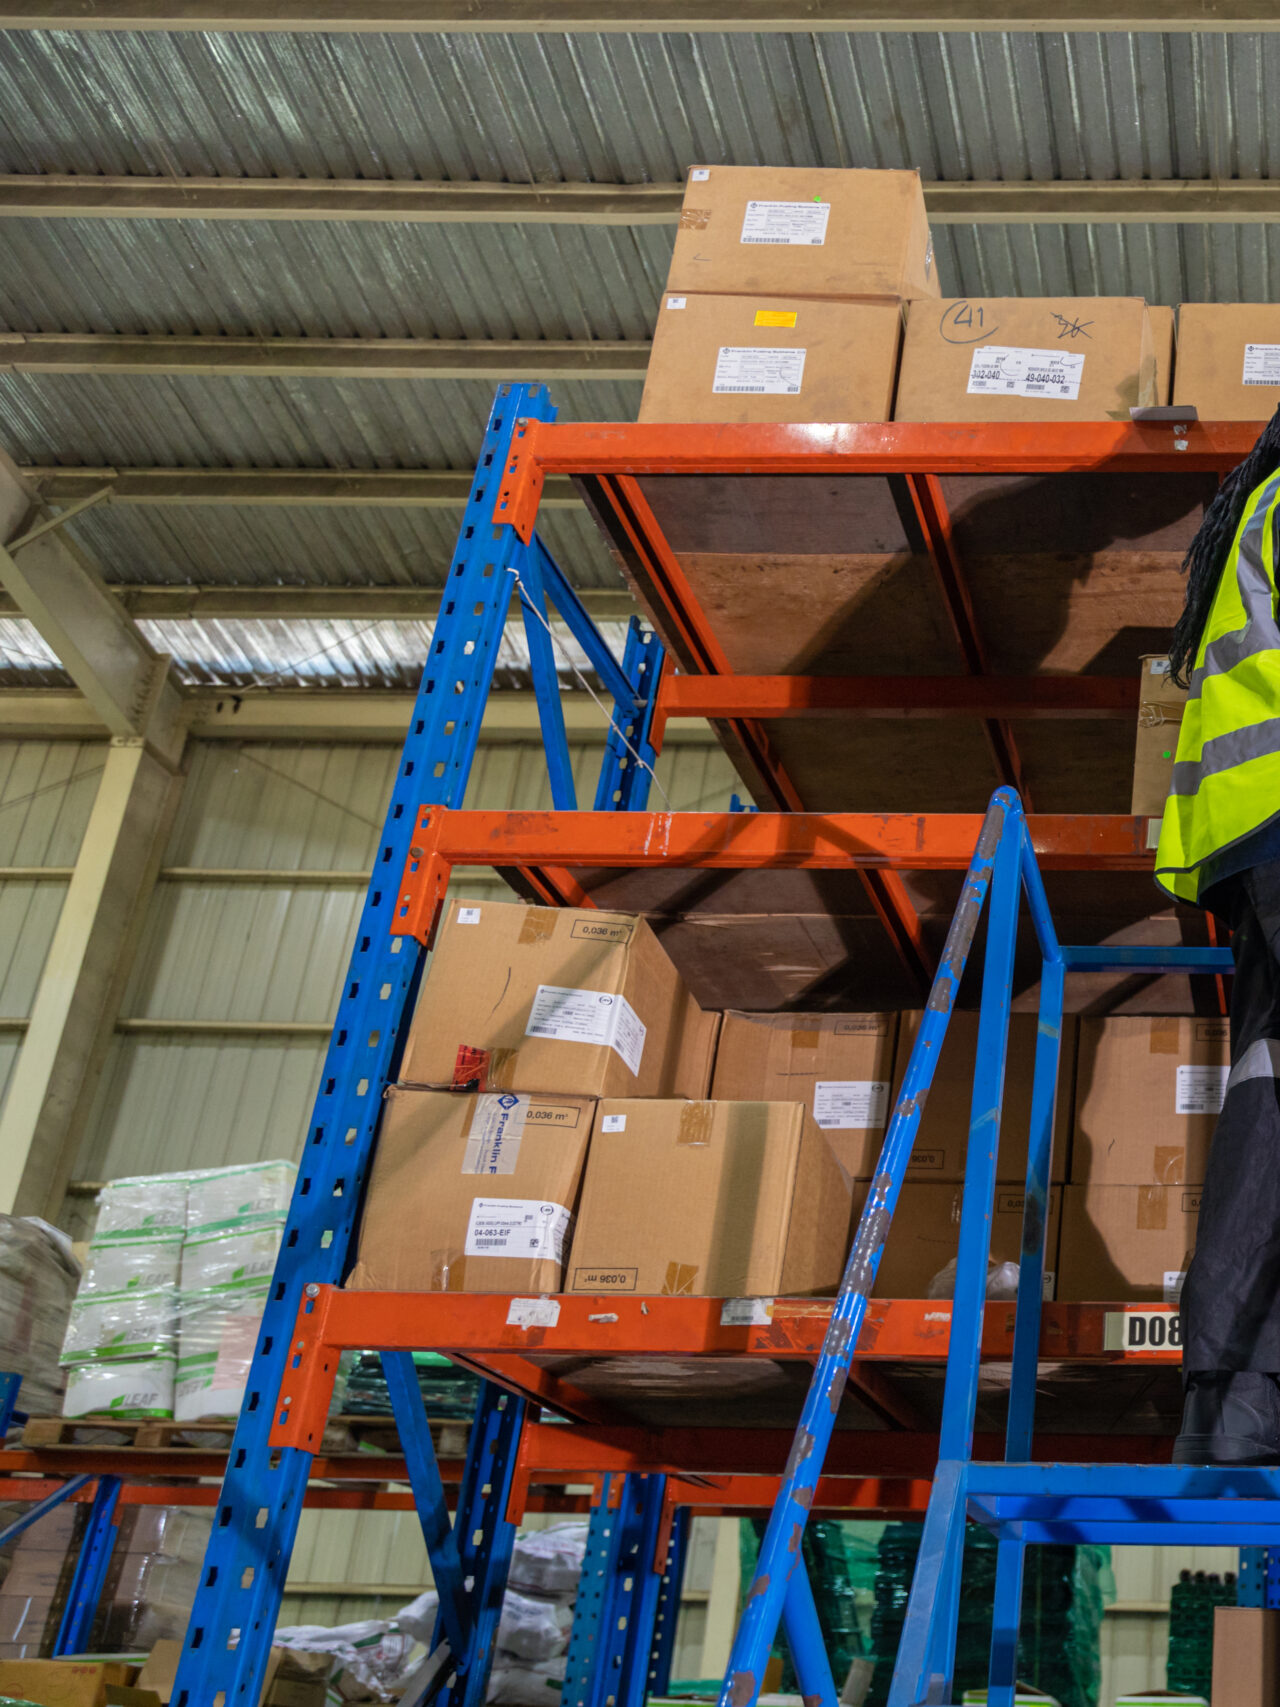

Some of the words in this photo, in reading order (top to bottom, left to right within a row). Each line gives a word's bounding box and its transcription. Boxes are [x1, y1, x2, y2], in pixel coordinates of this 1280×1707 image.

[953, 304, 984, 328] 41
[582, 926, 608, 936] 0,036
[526, 1110, 553, 1120] 0,036
[490, 1112, 510, 1164] Franklin
[474, 1228, 511, 1237] 04-063-EIF
[599, 1272, 627, 1284] 0,036
[123, 1393, 159, 1407] LEAF
